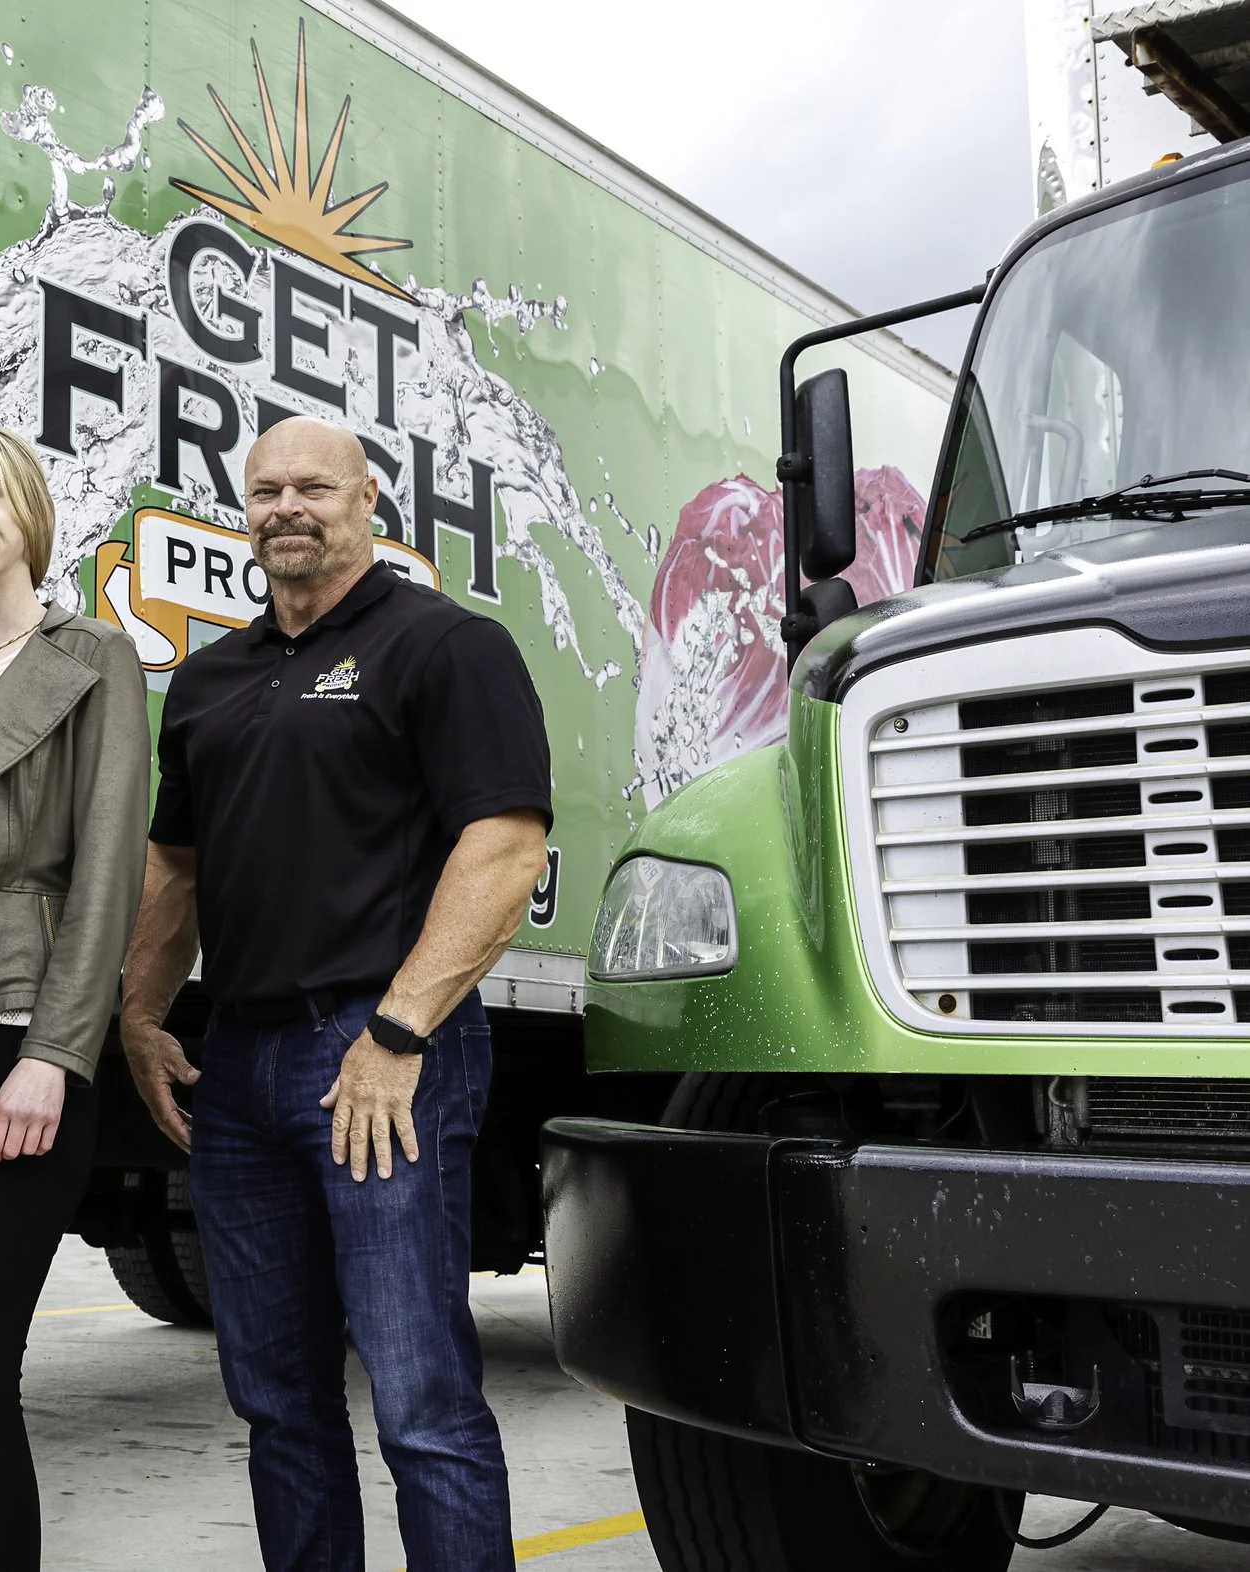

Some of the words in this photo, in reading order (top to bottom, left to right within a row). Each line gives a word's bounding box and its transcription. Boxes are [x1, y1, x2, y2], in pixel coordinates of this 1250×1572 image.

[169, 220, 420, 429] GET
[35, 277, 499, 599] FRSH
[315, 671, 360, 683] FRESH
[330, 667, 355, 676] GET
[325, 693, 360, 701] Everything
